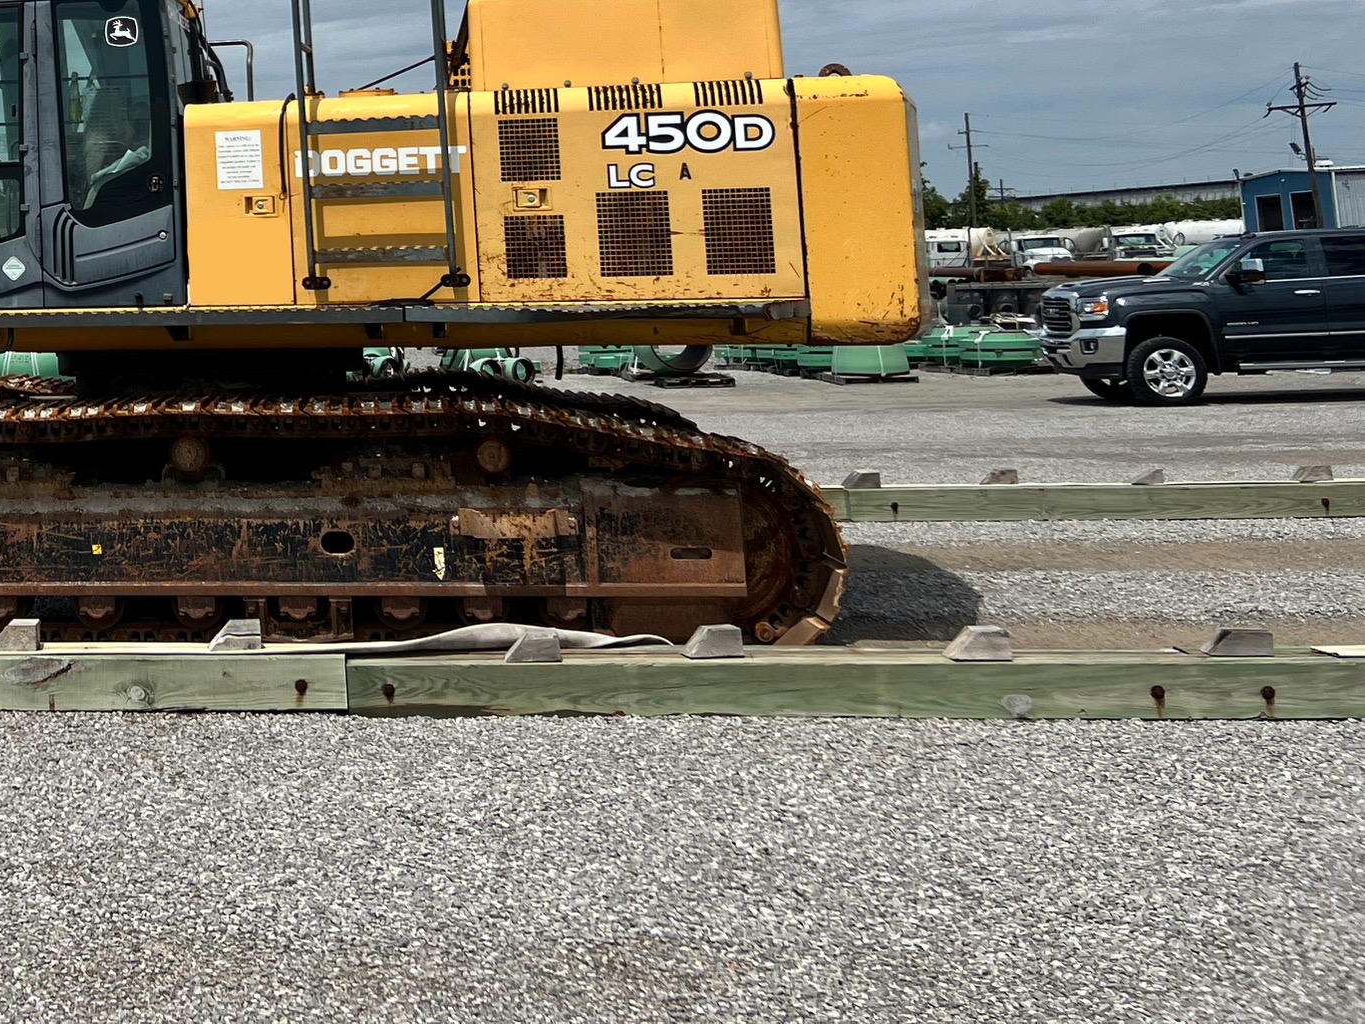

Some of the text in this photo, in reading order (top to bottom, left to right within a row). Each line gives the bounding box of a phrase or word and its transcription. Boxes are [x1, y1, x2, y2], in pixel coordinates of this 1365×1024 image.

[601, 109, 775, 155] 450D
[293, 145, 467, 178] DOGGETT
[607, 162, 656, 189] LC
